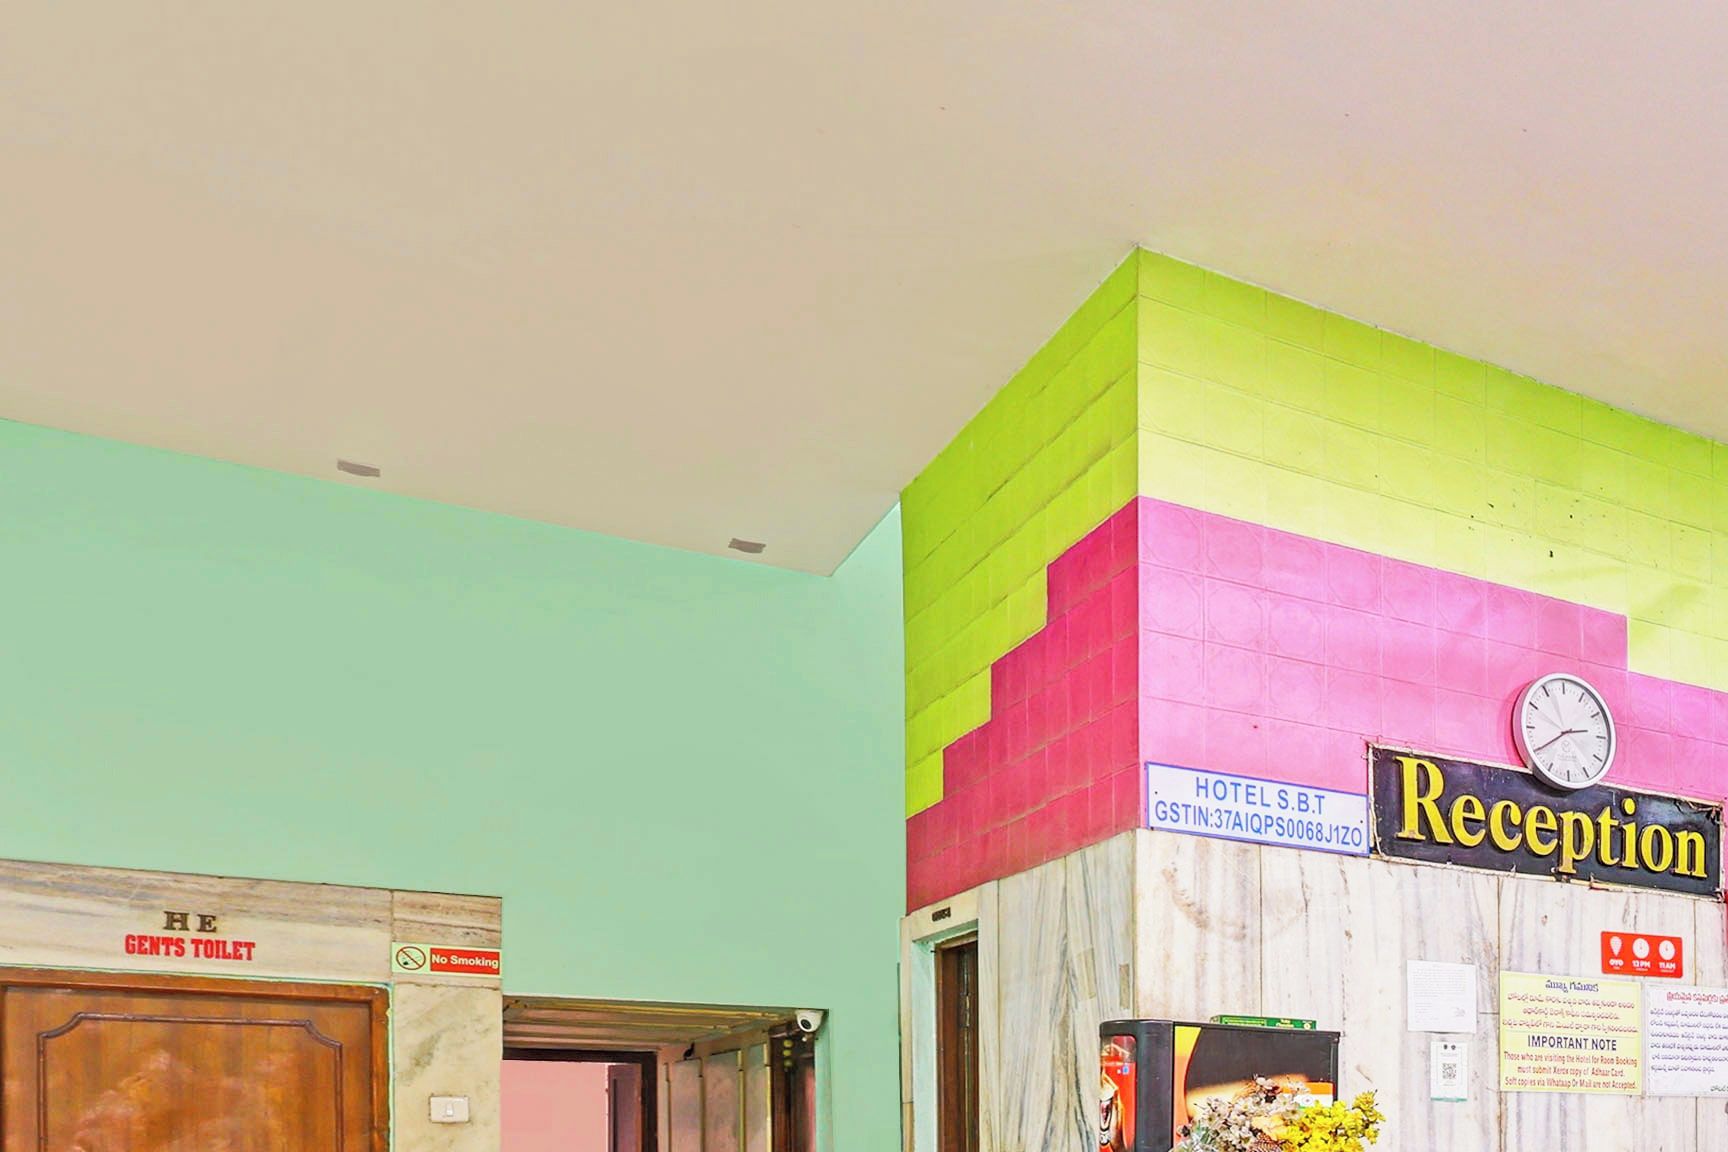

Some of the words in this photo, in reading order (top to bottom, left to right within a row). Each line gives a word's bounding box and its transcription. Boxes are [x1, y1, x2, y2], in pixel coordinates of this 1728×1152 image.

[1196, 777, 1271, 807] HOTEL
[1277, 789, 1325, 815] S.B.T
[1395, 756, 1708, 878] Reception
[125, 934, 186, 957] GENTS
[190, 938, 256, 961] TOILET
[431, 954, 448, 964] No
[450, 955, 499, 970] Smoking
[1528, 1035, 1588, 1049] IMPORTANT
[1592, 1039, 1617, 1051] NOTE
[1504, 1051, 1519, 1060] Those
[1521, 1053, 1533, 1061] who
[1600, 1056, 1614, 1064] Room
[1616, 1056, 1637, 1067] Booking
